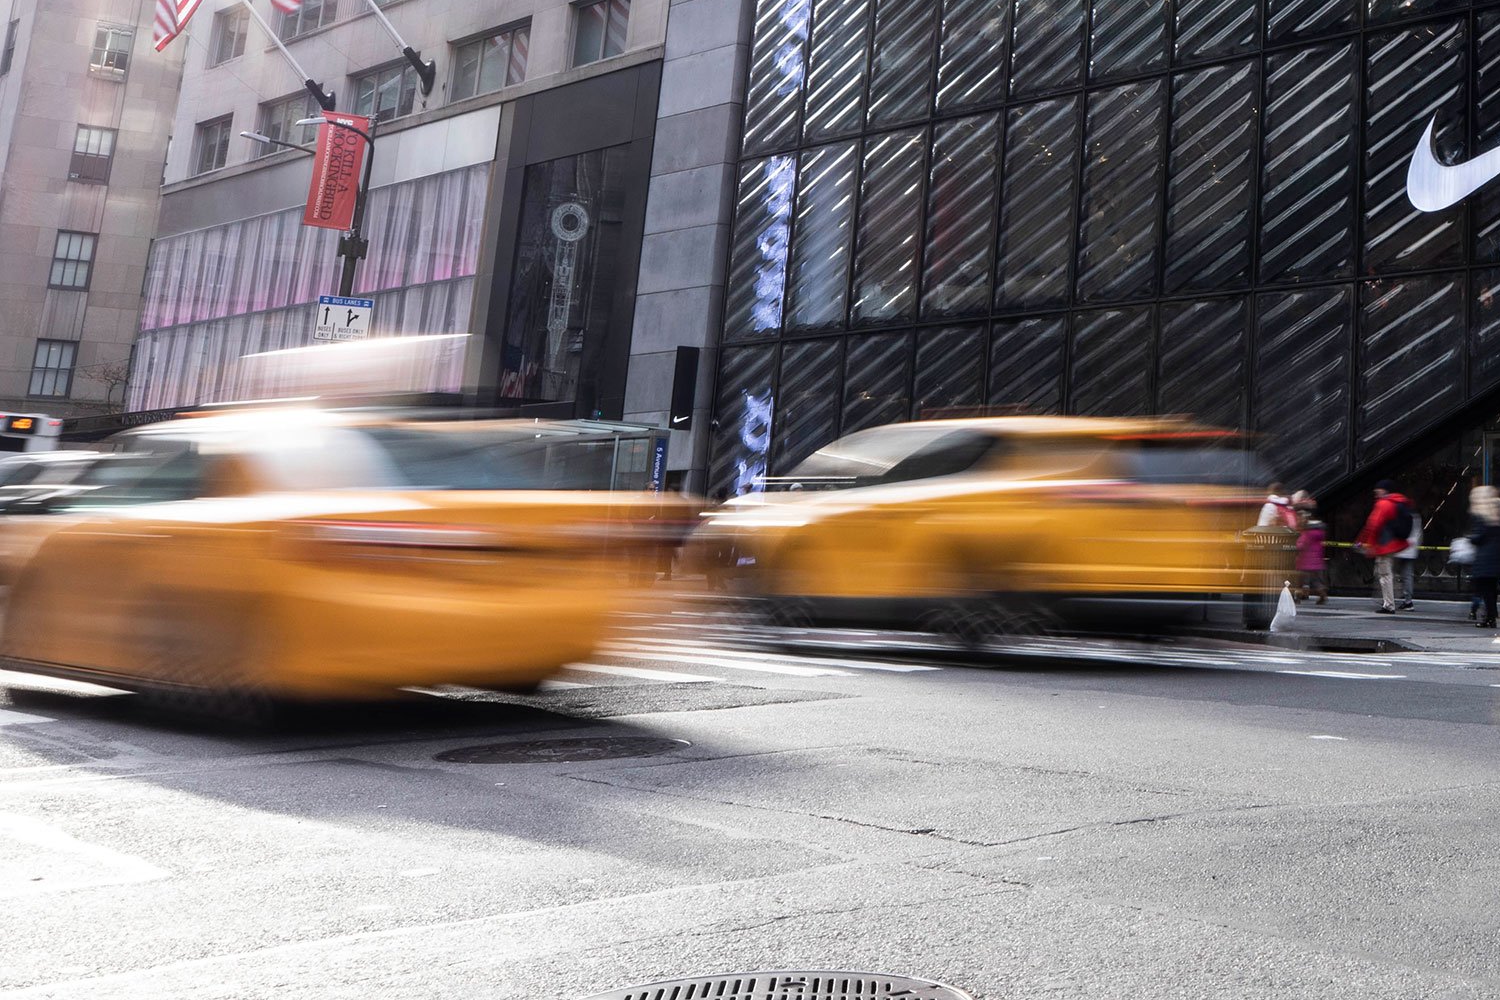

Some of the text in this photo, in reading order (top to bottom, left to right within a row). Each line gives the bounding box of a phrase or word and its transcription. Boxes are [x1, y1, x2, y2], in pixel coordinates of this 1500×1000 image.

[319, 126, 346, 220] MOCKINGBIRD
[340, 149, 355, 179] KILL
[337, 184, 348, 194] A
[653, 453, 662, 479] Avenue
